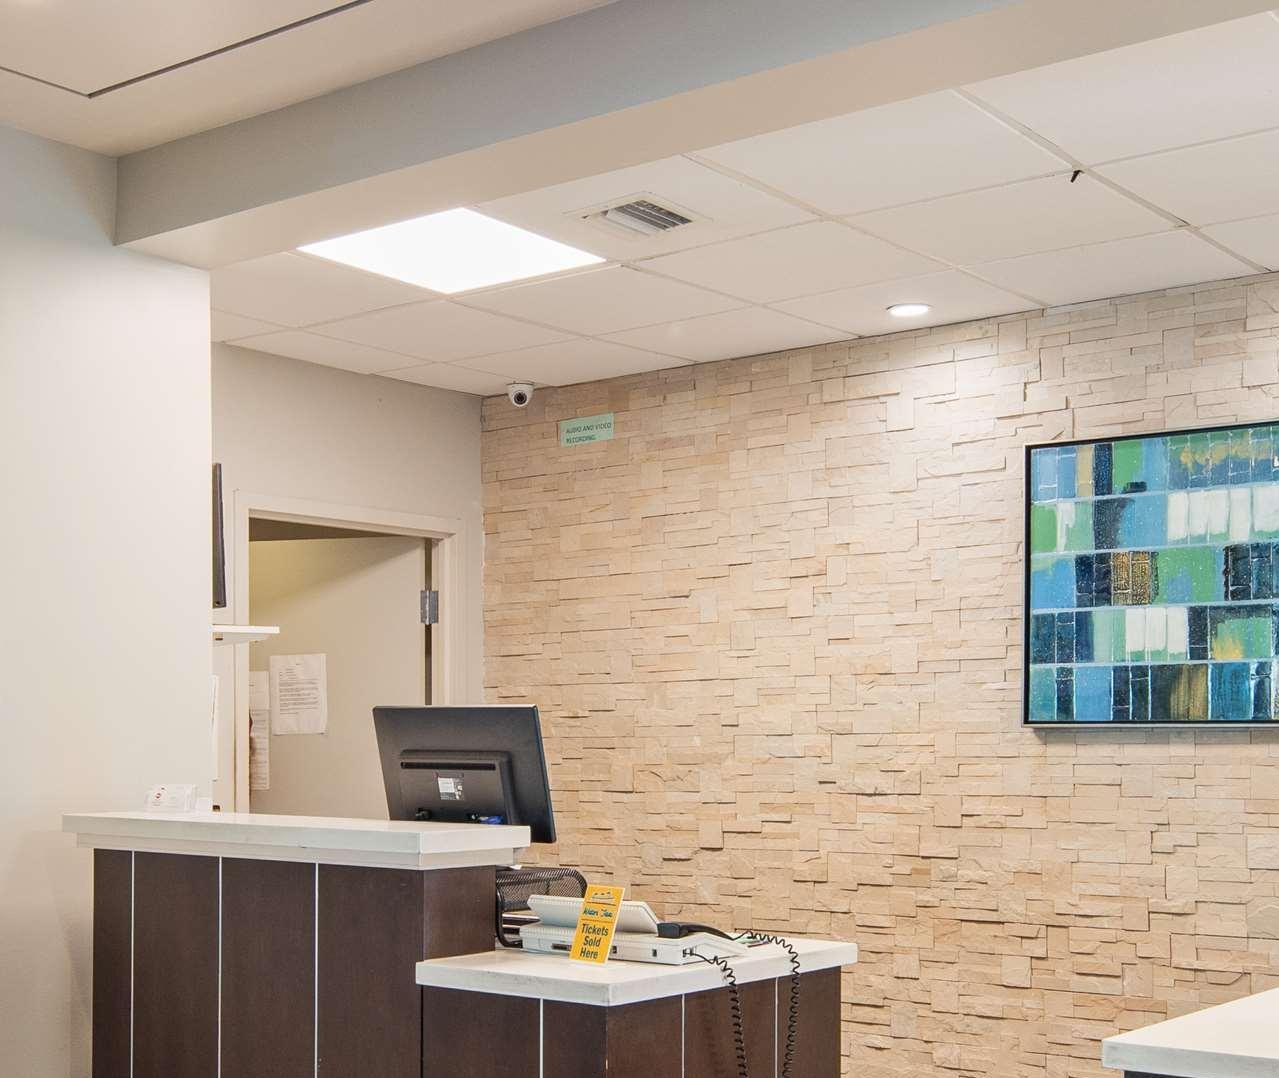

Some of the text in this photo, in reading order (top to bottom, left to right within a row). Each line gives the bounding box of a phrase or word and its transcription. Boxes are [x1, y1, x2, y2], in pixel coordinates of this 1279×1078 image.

[581, 923, 609, 936] Tickets
[583, 935, 601, 947] Sold
[580, 946, 598, 959] Here
